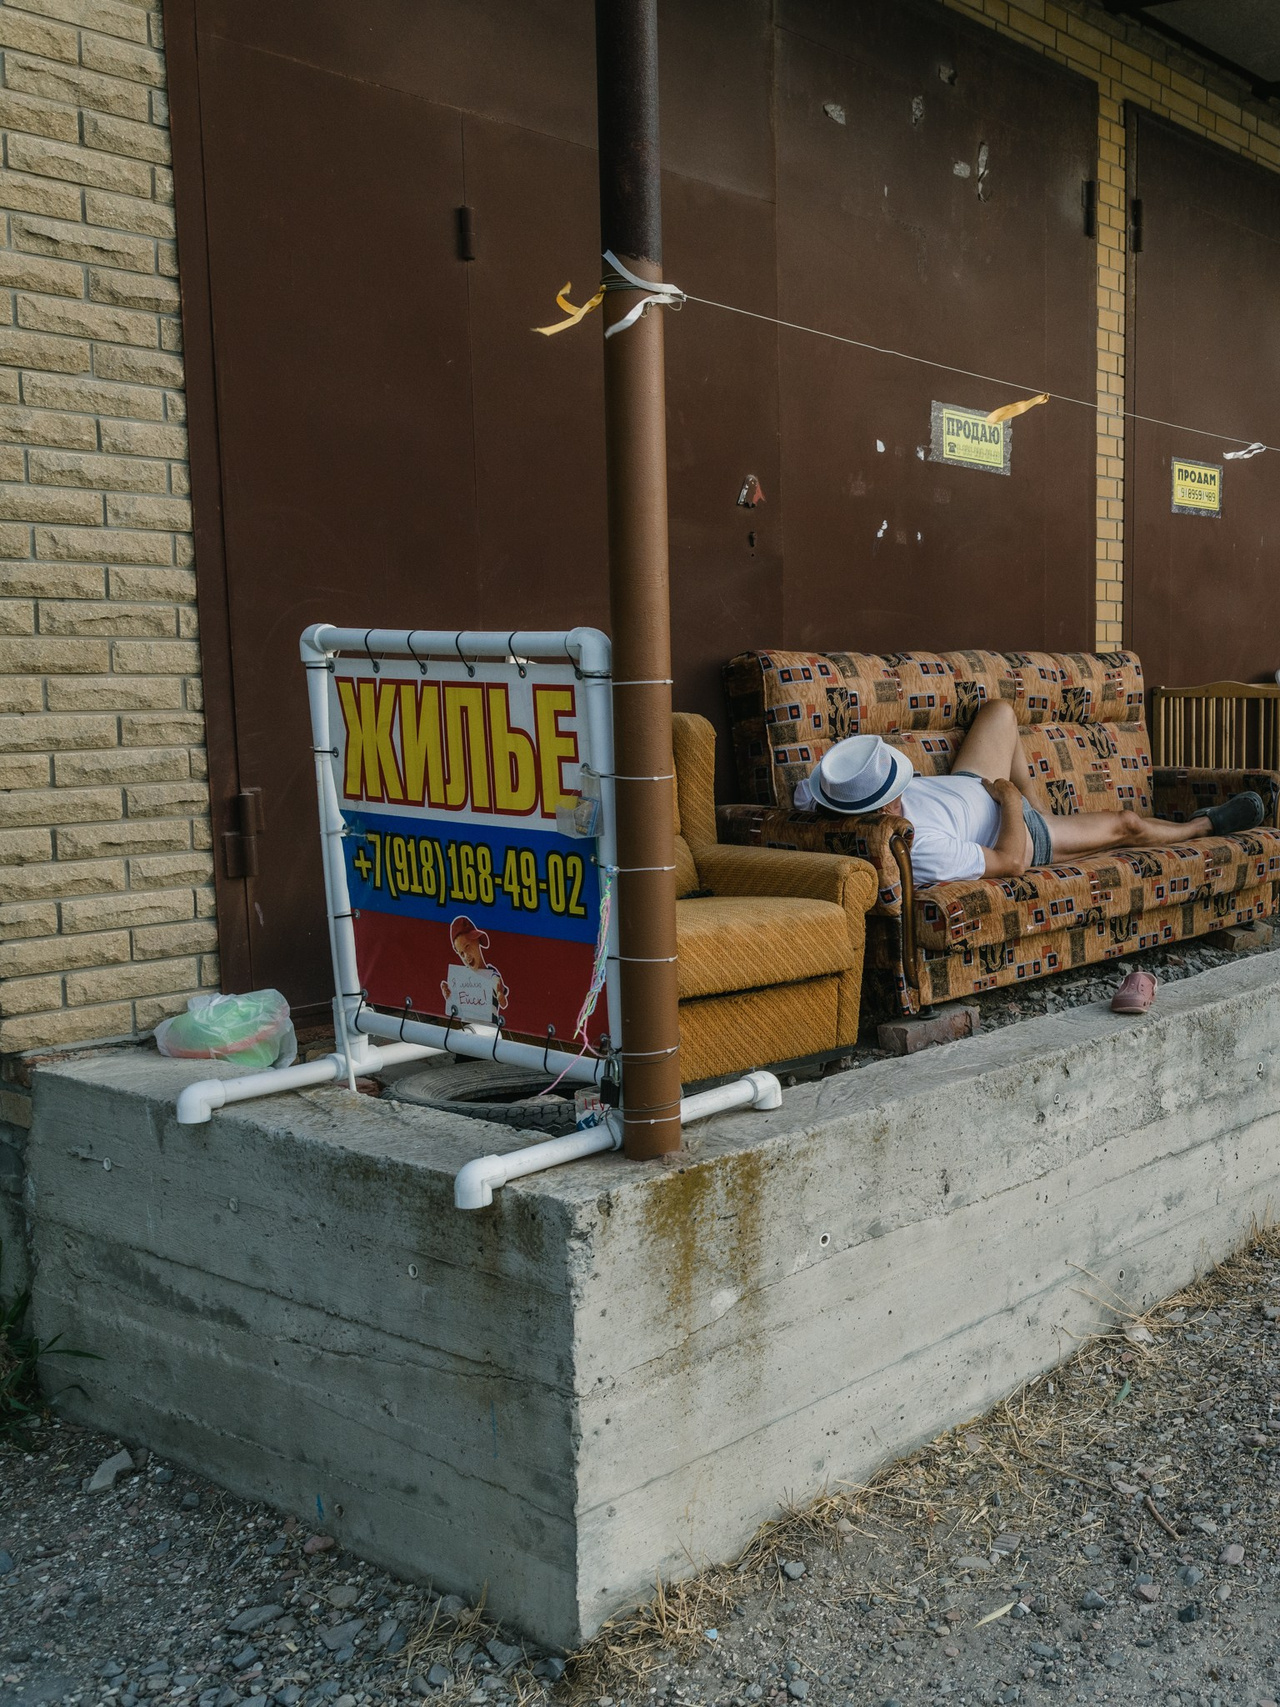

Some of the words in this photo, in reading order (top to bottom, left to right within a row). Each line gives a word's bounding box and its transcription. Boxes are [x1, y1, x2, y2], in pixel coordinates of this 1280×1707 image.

[946, 416, 1000, 445] ПРОДАЮ
[1177, 467, 1216, 486] ПРОДАМ
[335, 675, 583, 819] ЖИЛЬЕ
